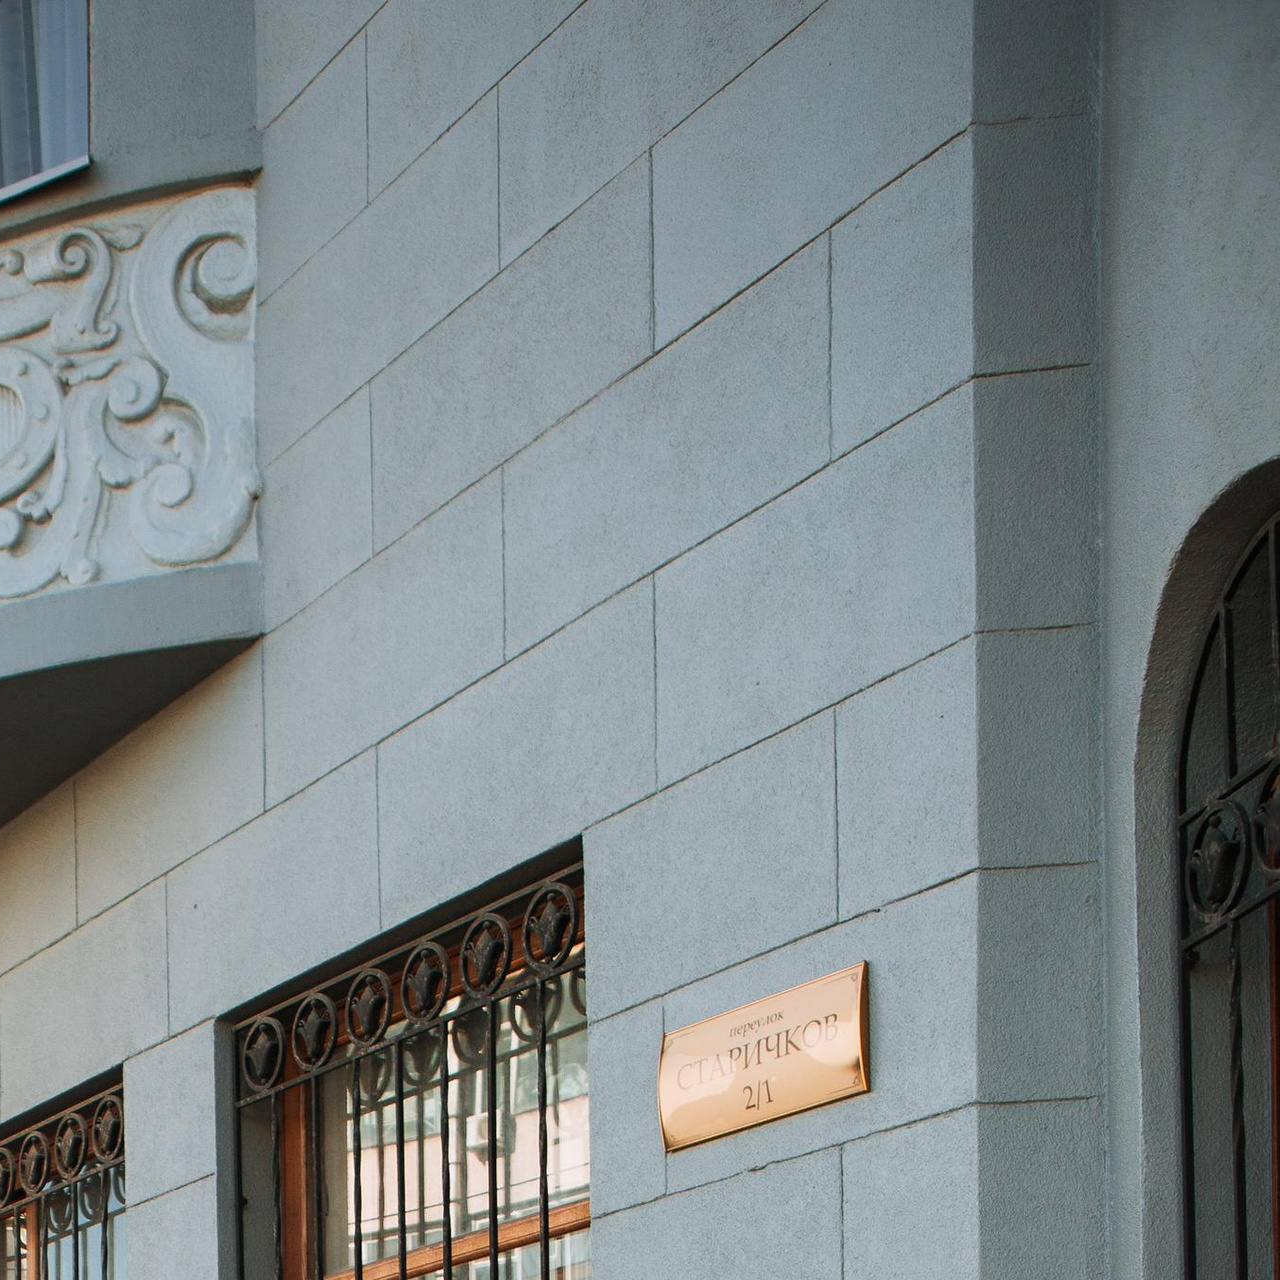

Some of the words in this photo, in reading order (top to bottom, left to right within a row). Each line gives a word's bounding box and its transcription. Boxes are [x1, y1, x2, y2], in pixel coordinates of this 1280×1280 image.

[729, 1010, 784, 1038] переулок
[677, 1013, 838, 1092] СТАРИЧКОВ
[743, 1079, 773, 1111] 2/1
